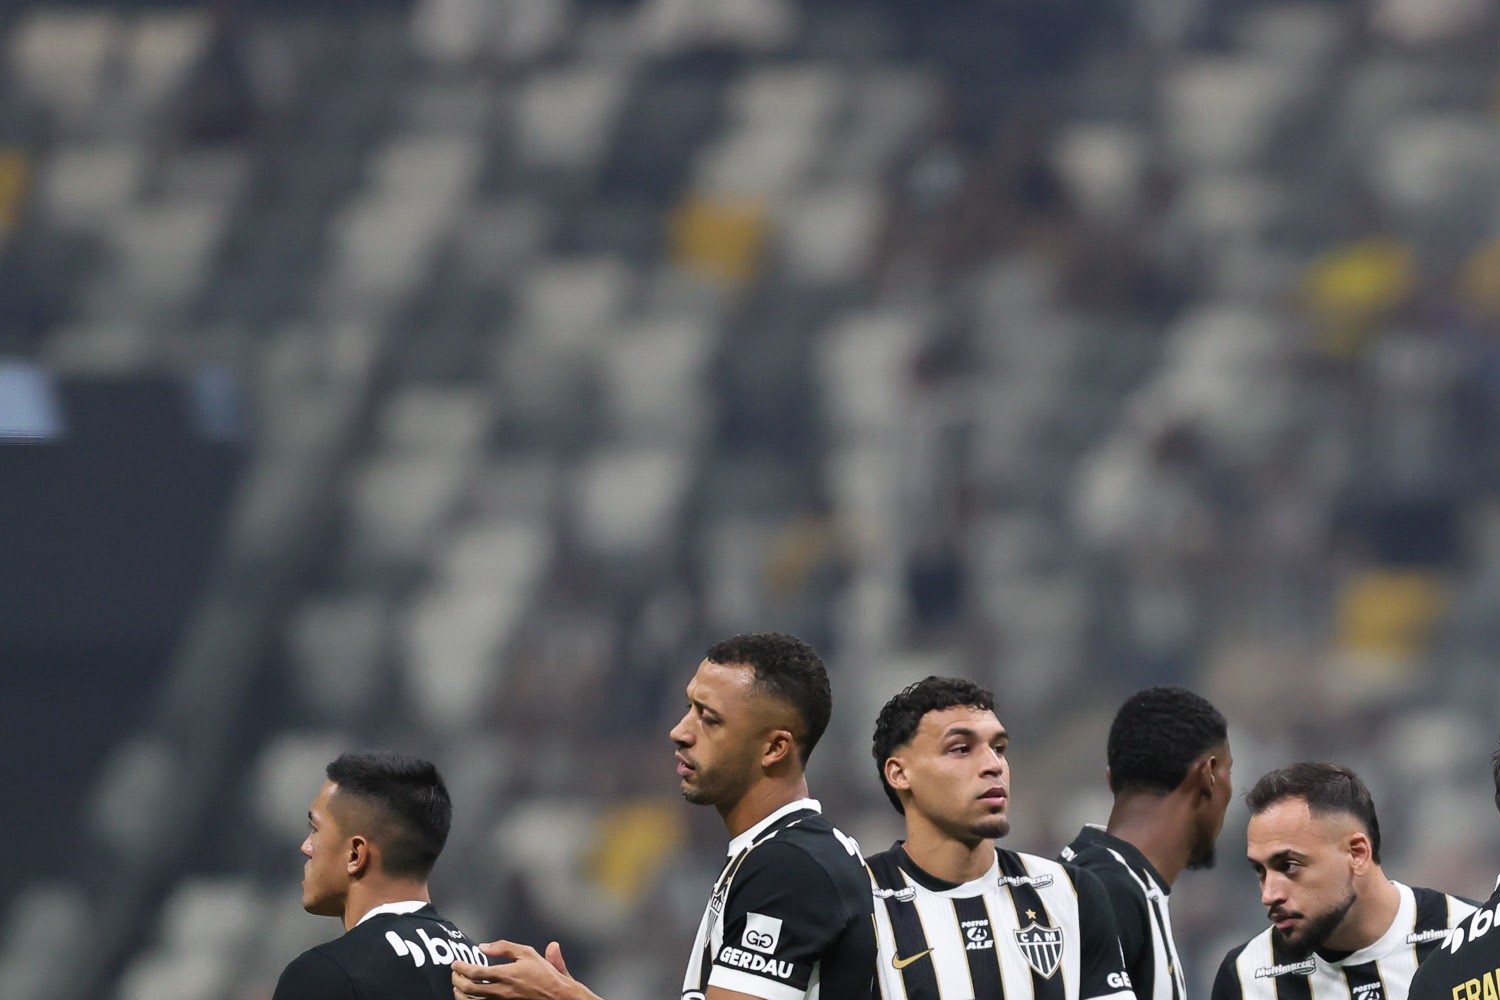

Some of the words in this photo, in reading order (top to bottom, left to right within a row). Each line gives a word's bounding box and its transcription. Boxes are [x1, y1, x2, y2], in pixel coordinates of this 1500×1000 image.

[962, 920, 989, 928] POSTOS
[1020, 932, 1057, 943] CAM
[966, 940, 994, 950] ALE
[720, 946, 794, 979] GERDAU
[1353, 982, 1381, 994] POSTOS
